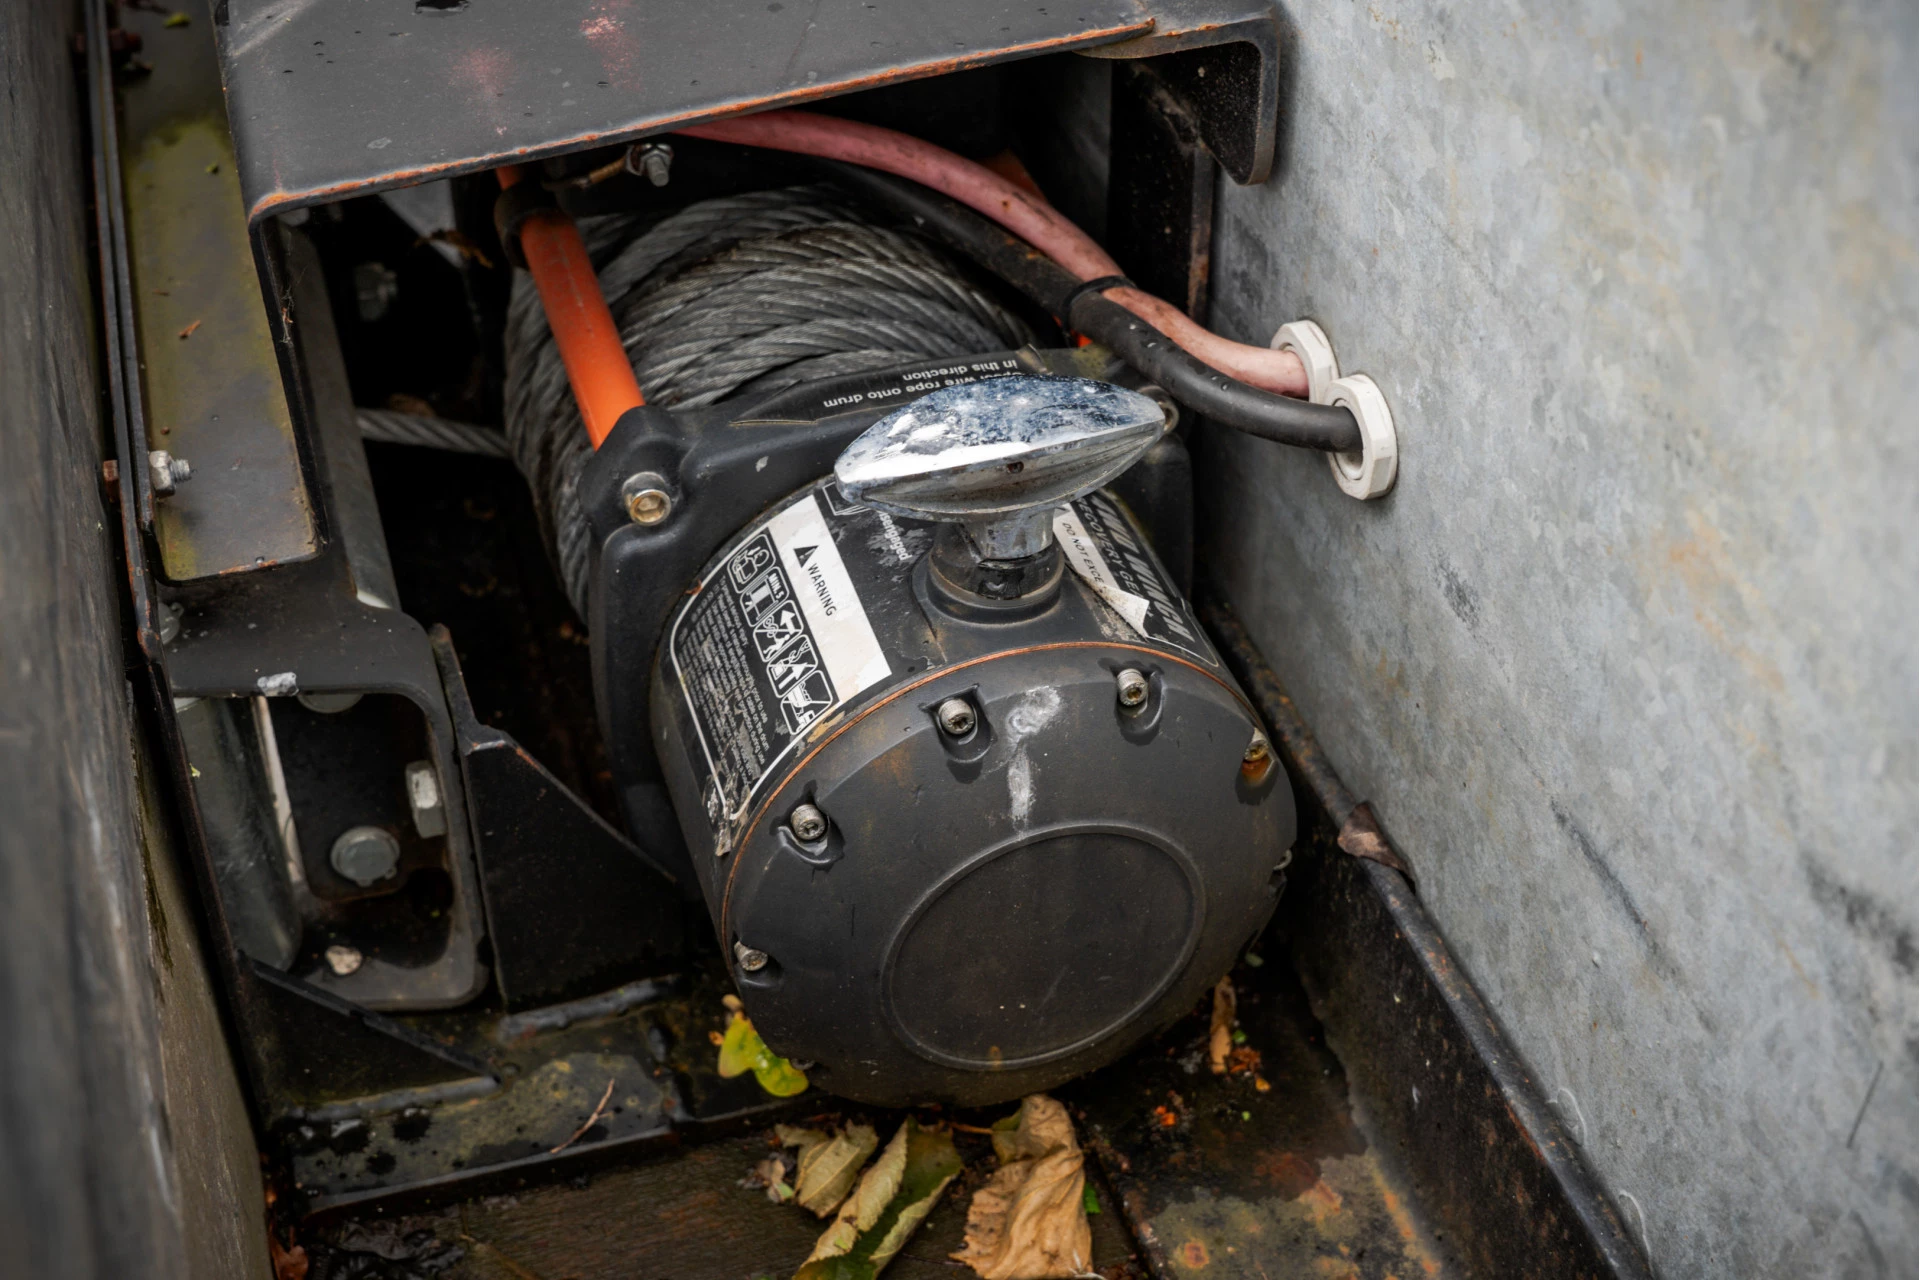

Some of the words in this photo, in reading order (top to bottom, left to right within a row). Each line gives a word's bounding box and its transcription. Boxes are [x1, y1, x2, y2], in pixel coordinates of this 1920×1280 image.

[902, 365, 968, 382] direction
[971, 361, 1000, 372] this
[1002, 359, 1018, 369] in
[867, 387, 902, 400] onto
[906, 380, 941, 393] rope
[823, 393, 863, 408] drum
[876, 511, 913, 560] isengaged
[1076, 498, 1124, 568] RECOVERY
[1062, 522, 1075, 536] DO
[1072, 537, 1089, 558] NOT
[1084, 557, 1104, 583] EXCE
[807, 563, 837, 617] WARNING
[1123, 552, 1195, 643] WINCH
[731, 631, 743, 657] manual
[738, 652, 755, 690] thoroughly
[750, 685, 760, 704] prior
[759, 708, 768, 724] use
[745, 694, 756, 715] cable
[755, 720, 764, 735] the
[748, 728, 761, 755] during
[759, 731, 770, 752] drum
